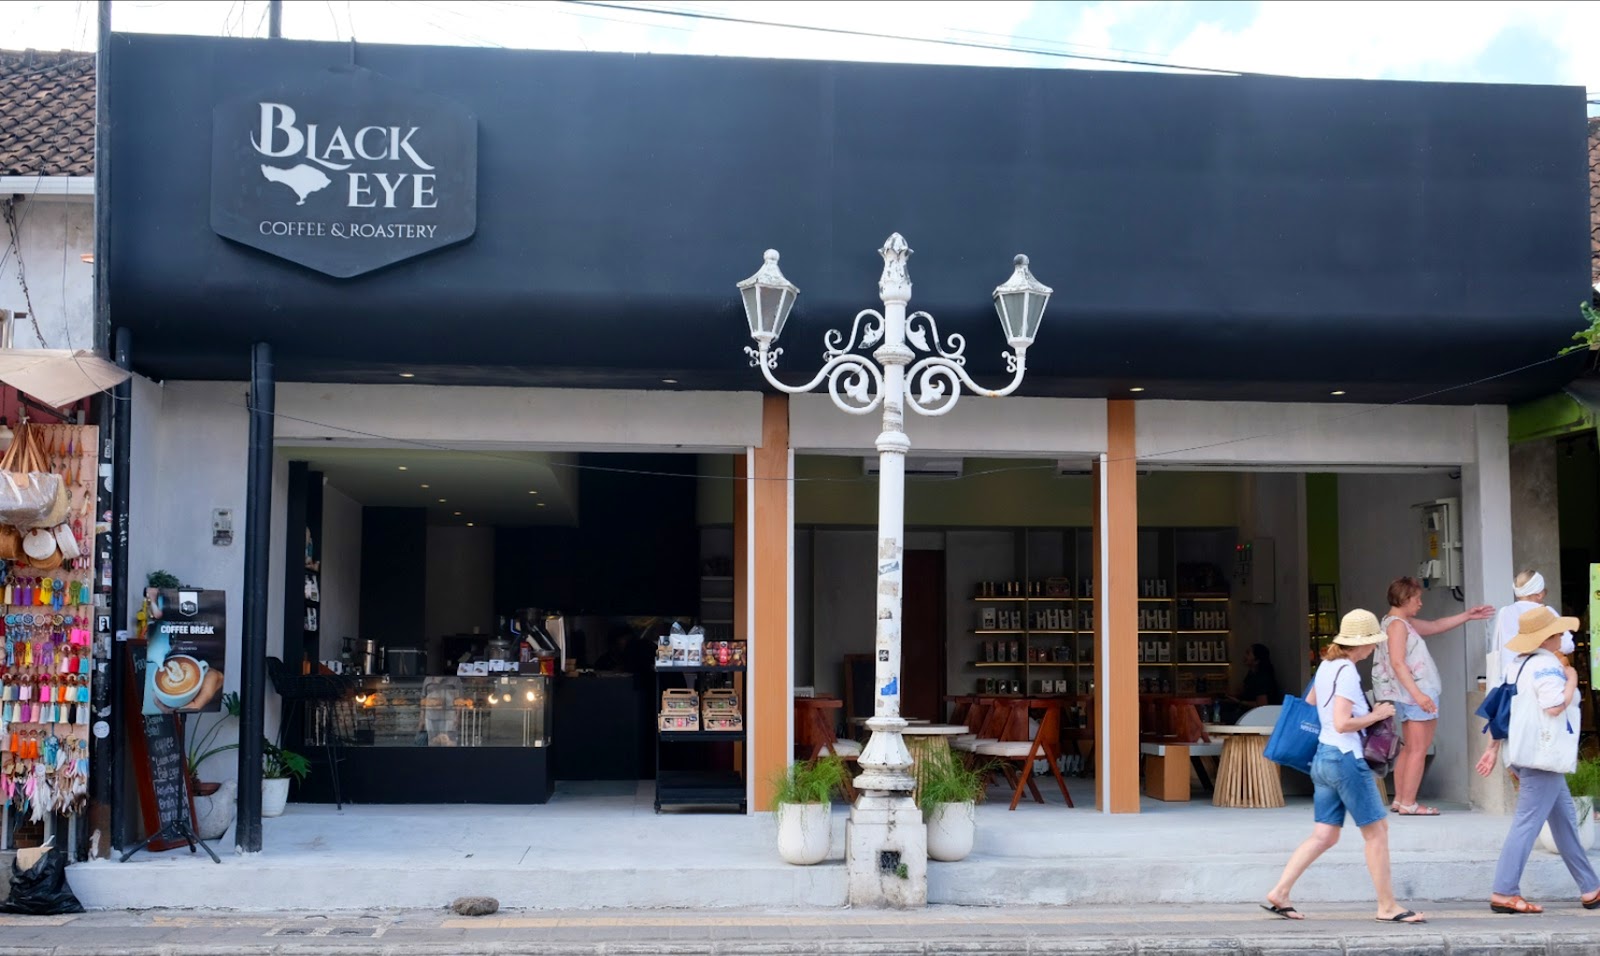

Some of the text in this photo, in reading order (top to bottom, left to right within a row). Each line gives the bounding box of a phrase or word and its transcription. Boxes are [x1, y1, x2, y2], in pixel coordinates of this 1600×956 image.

[347, 172, 438, 209] EYE
[259, 220, 438, 240] COFFEE & ROASTERY
[160, 625, 214, 635] COFFEE BREAK
